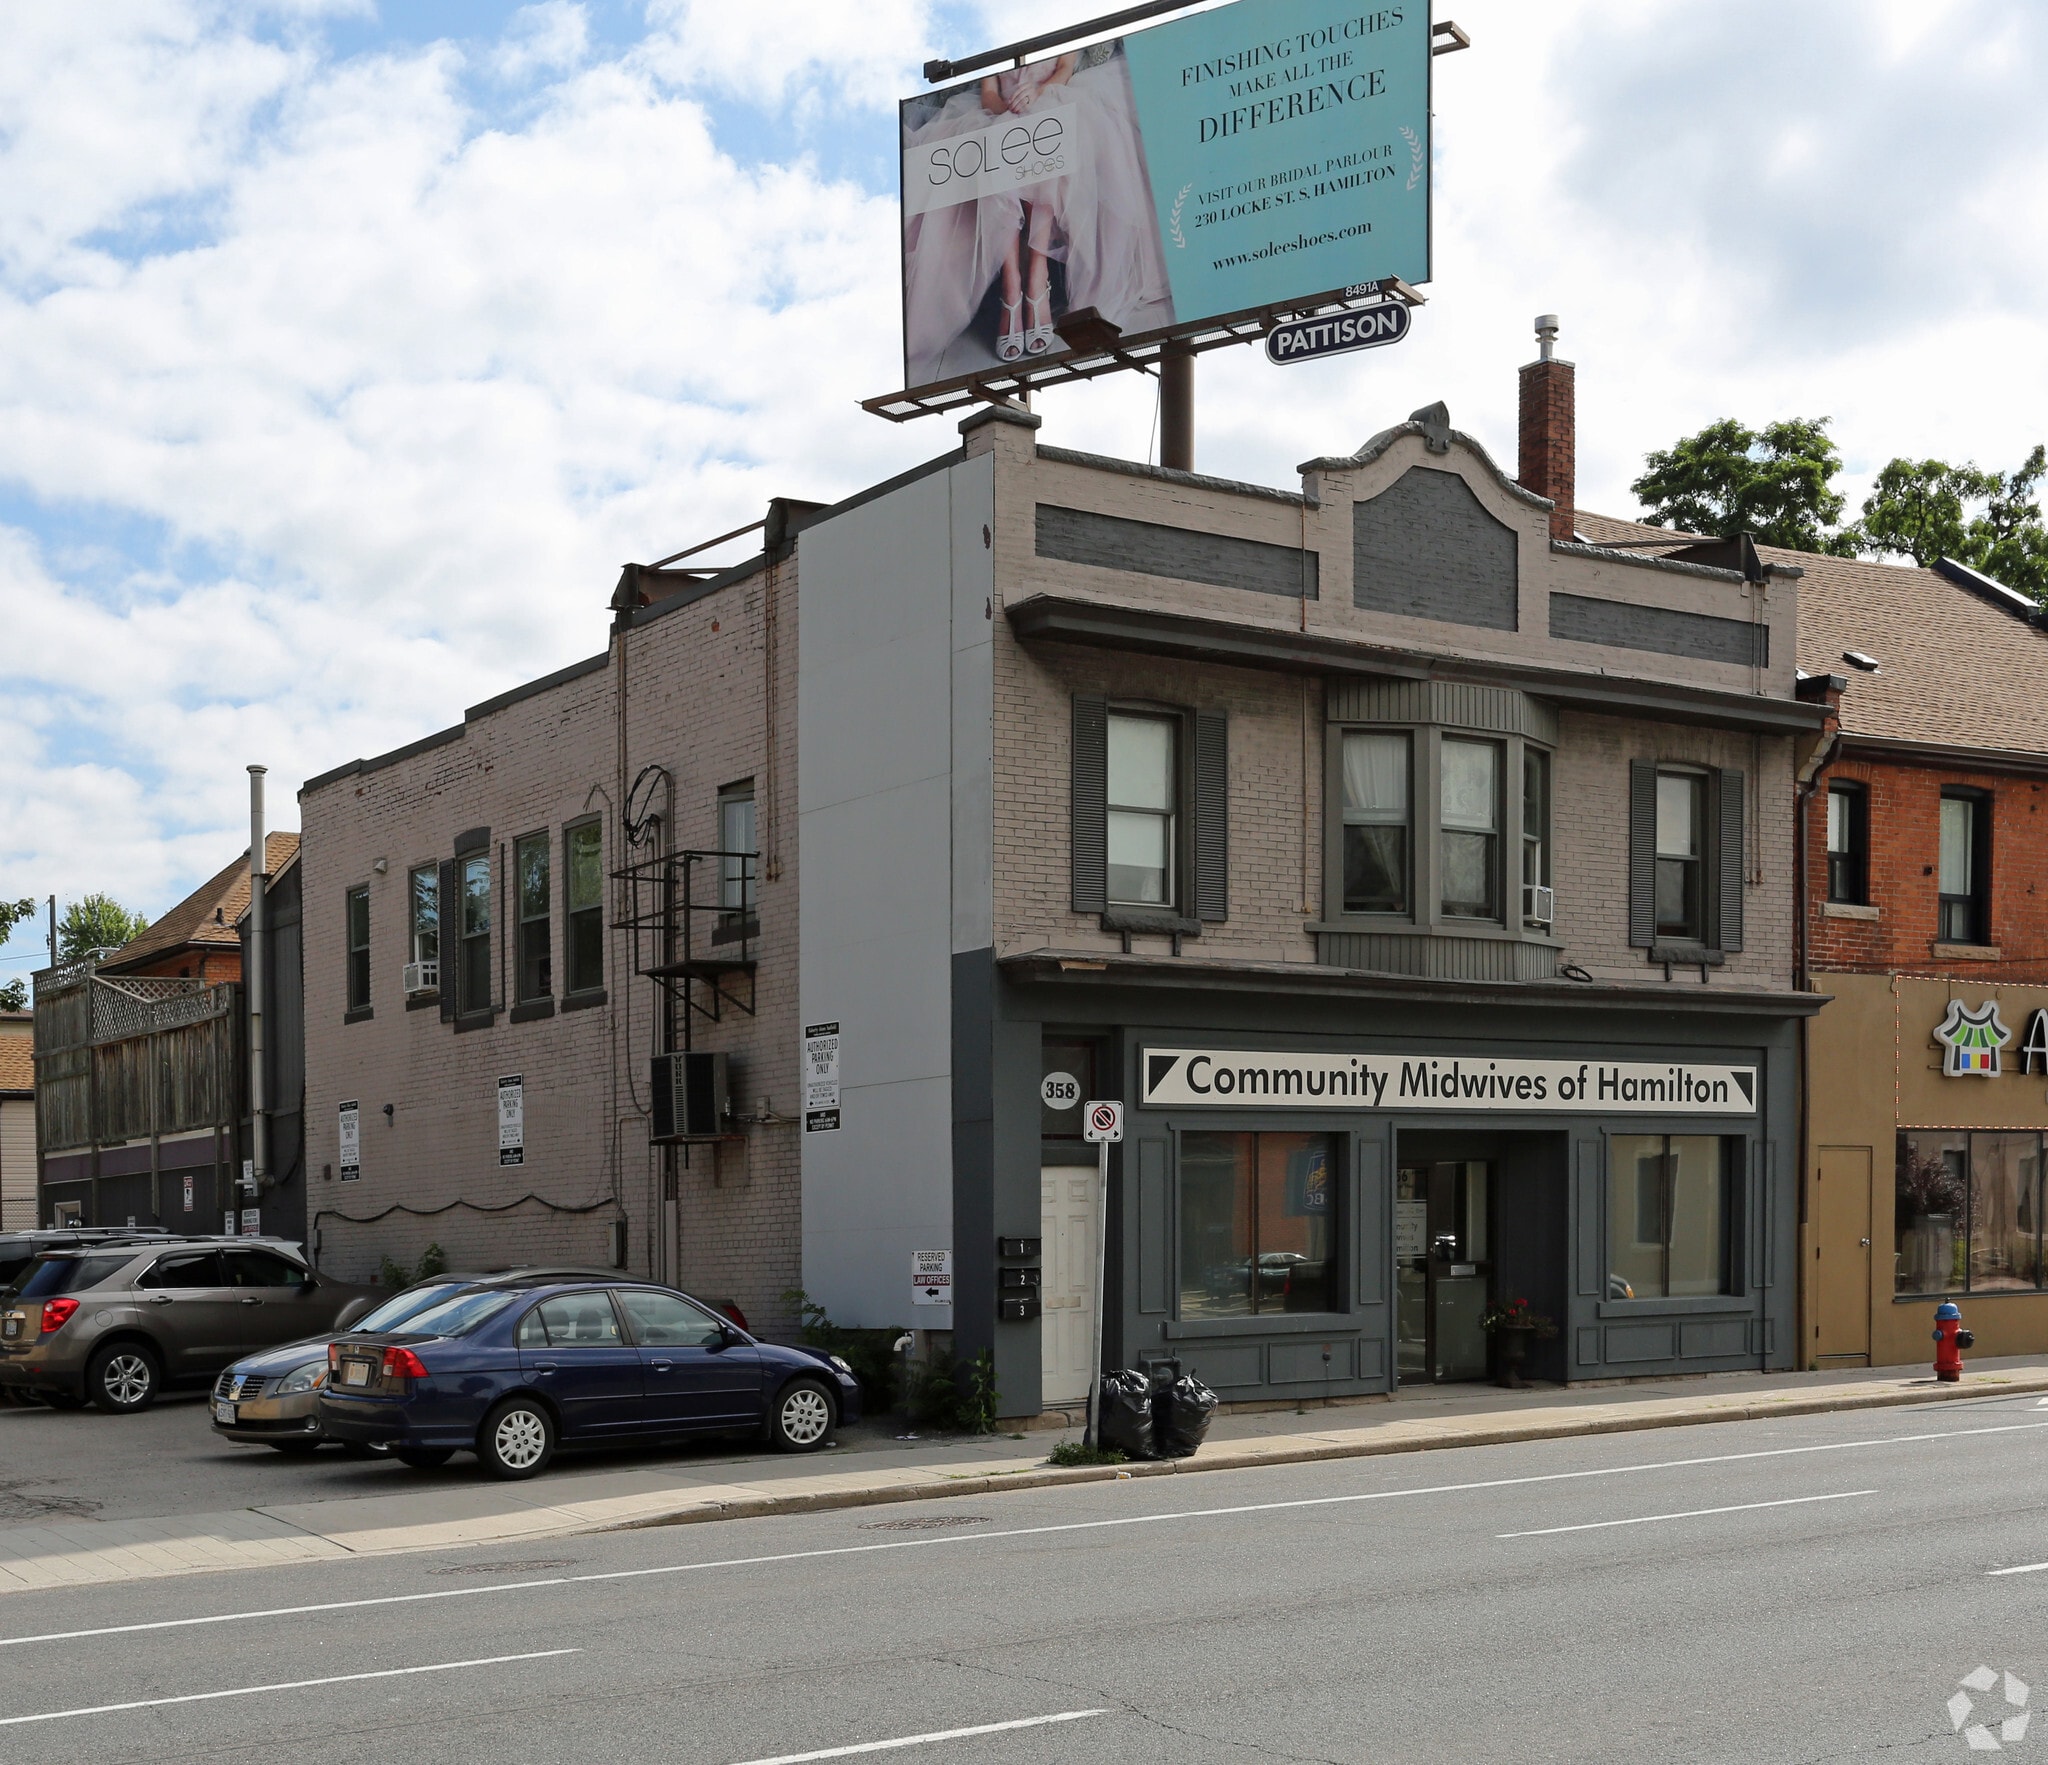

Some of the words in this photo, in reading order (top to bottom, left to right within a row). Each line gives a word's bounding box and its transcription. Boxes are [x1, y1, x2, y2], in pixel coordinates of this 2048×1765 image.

[1181, 38, 1291, 87] FINISHING
[1296, 7, 1404, 53] TOUCHES
[1229, 72, 1277, 99] MAKE
[1281, 63, 1315, 85] ALL
[1318, 51, 1353, 73] THE
[1198, 69, 1386, 144] DIFFERENCE
[1198, 186, 1235, 206] VISIT
[1237, 178, 1267, 196] OUR
[1270, 163, 1322, 187] BRIDAL
[1326, 144, 1393, 173] PARLOUR
[1195, 210, 1218, 228] 230
[1221, 197, 1272, 222] LOCKE
[1275, 190, 1296, 207] ST.
[1314, 164, 1397, 197] HAMILTON
[1213, 221, 1372, 271] www.soleeshoes.com
[1345, 281, 1379, 298] 8491A
[1278, 310, 1397, 355] PATTISON
[807, 1038, 839, 1053] AUTHORIZED
[812, 1050, 834, 1064] PARKING
[816, 1063, 830, 1075] ONLY
[1186, 1055, 1388, 1107] Community
[1399, 1060, 1547, 1100] Midwives
[1558, 1064, 1588, 1101] of
[1598, 1067, 1728, 1103] Hamilton
[1046, 1082, 1075, 1099] 358
[917, 1251, 946, 1262] RESERVED
[1020, 1242, 1024, 1254] 1
[920, 1262, 943, 1272] PARKING
[914, 1275, 927, 1285] LAW
[927, 1275, 950, 1285] OFFICES
[1020, 1274, 1026, 1286] 2
[1020, 1305, 1025, 1316] 3
